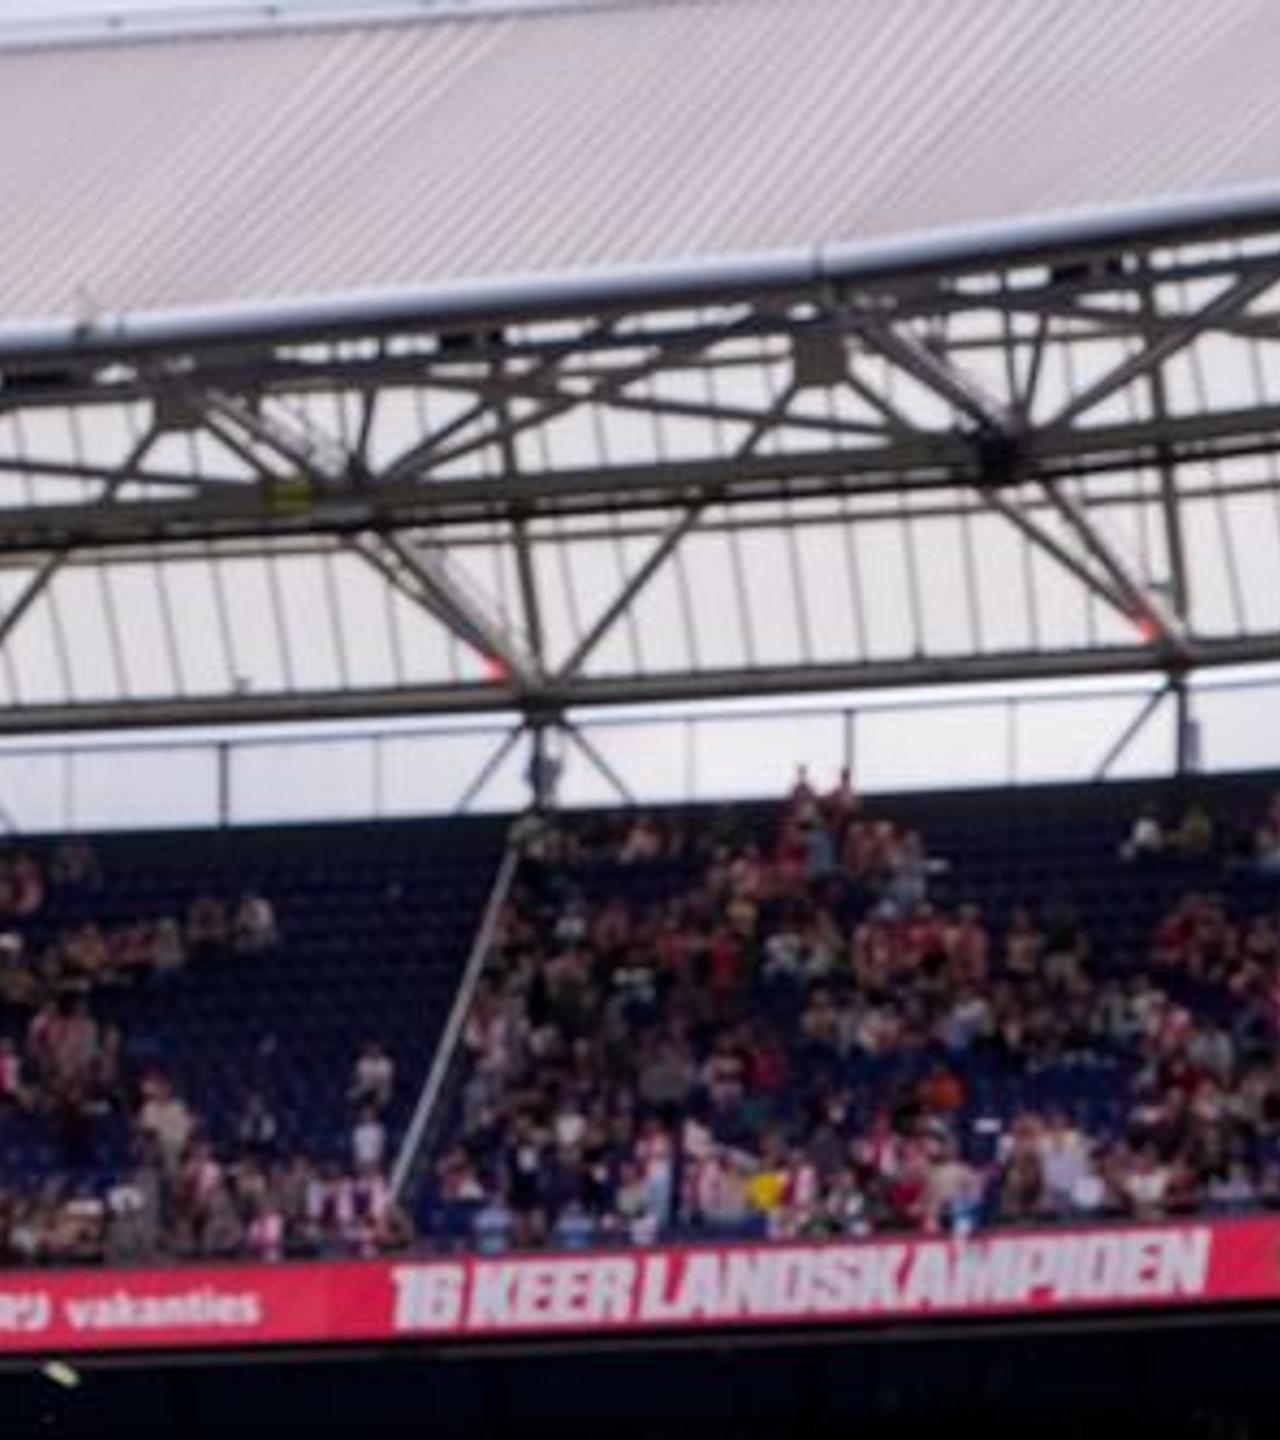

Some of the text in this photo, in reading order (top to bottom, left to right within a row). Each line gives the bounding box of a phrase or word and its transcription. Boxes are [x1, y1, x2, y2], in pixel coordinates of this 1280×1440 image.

[65, 1287, 262, 1329] vakanties
[390, 1264, 464, 1331] 16
[469, 1256, 638, 1326] KEER
[639, 1229, 1212, 1318] LANDSKAMPIOEN
